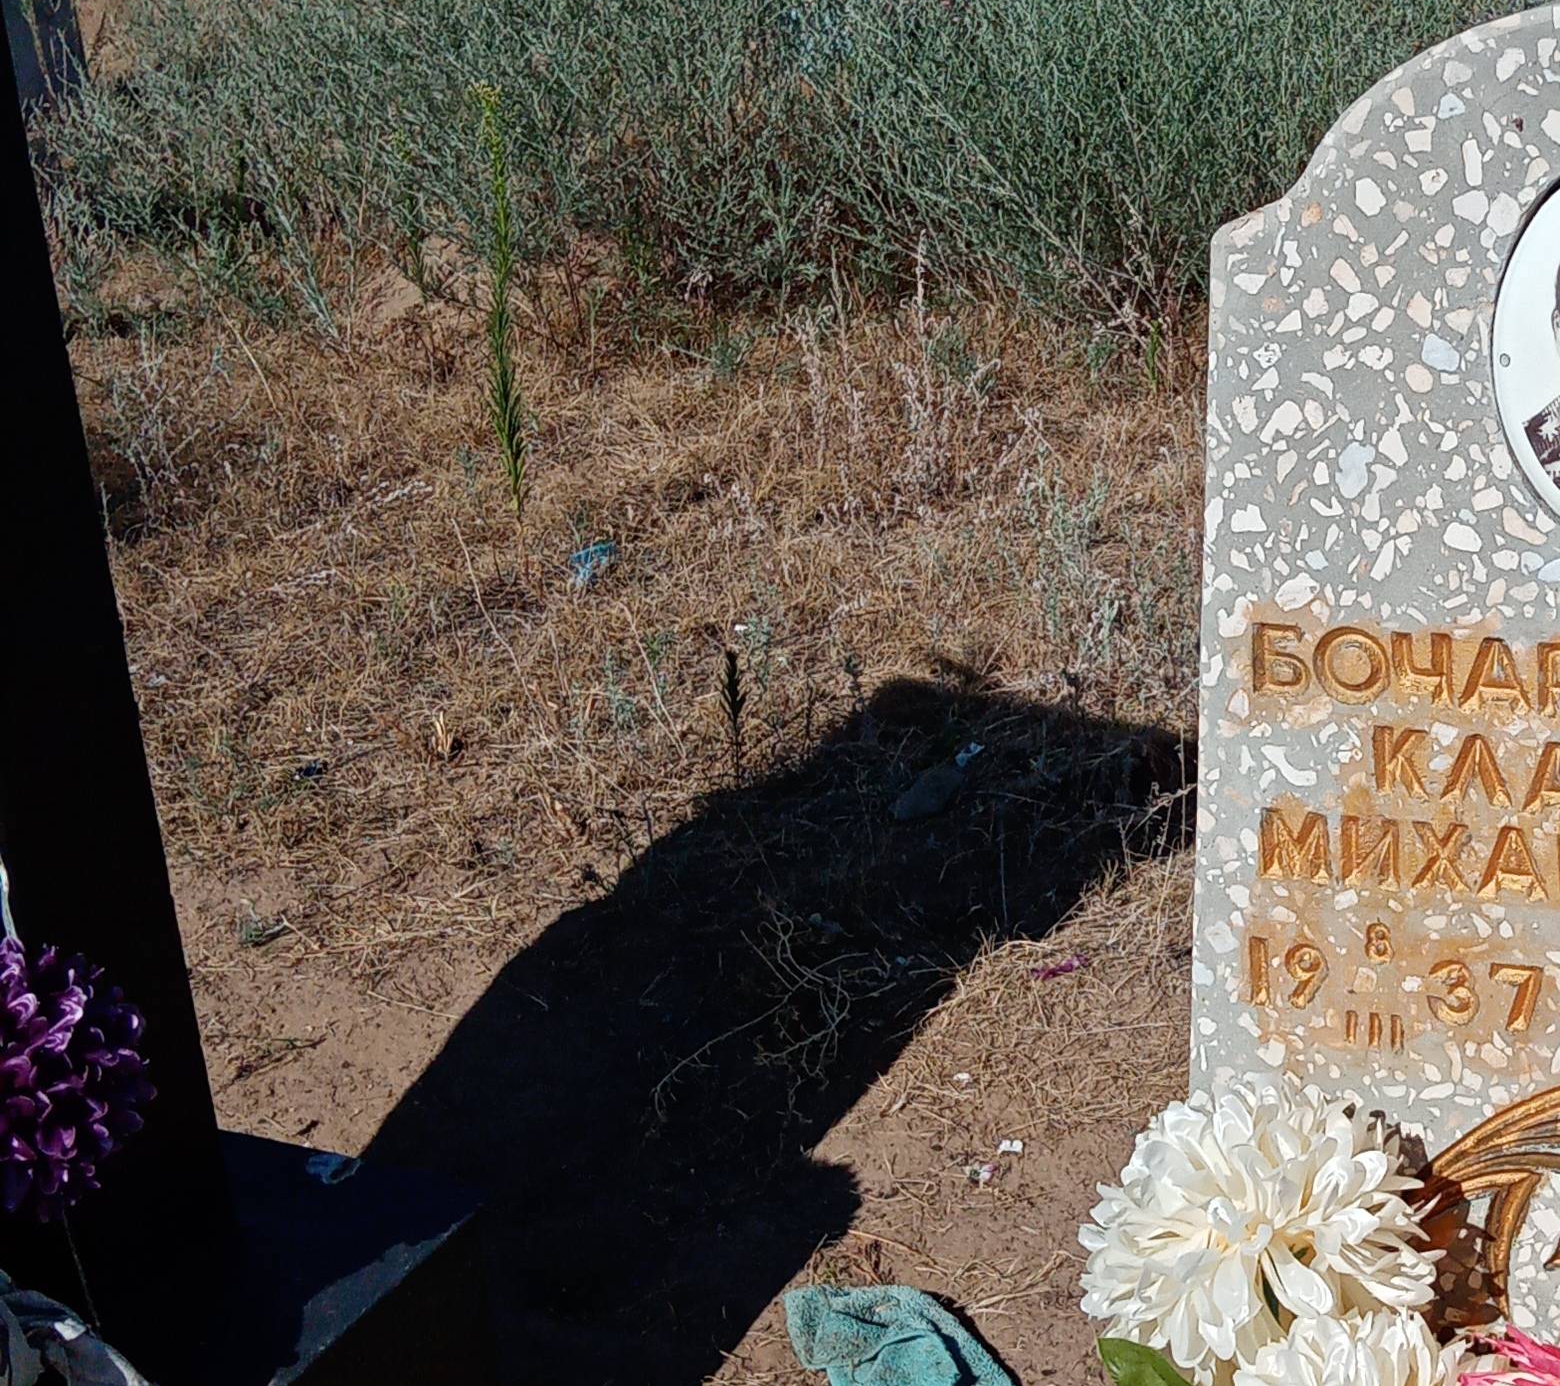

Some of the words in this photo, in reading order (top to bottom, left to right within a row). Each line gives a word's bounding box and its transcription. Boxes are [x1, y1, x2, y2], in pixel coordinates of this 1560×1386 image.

[1249, 935, 1329, 1010] 19
[1364, 920, 1395, 965] 8
[1427, 959, 1545, 1035] 37
